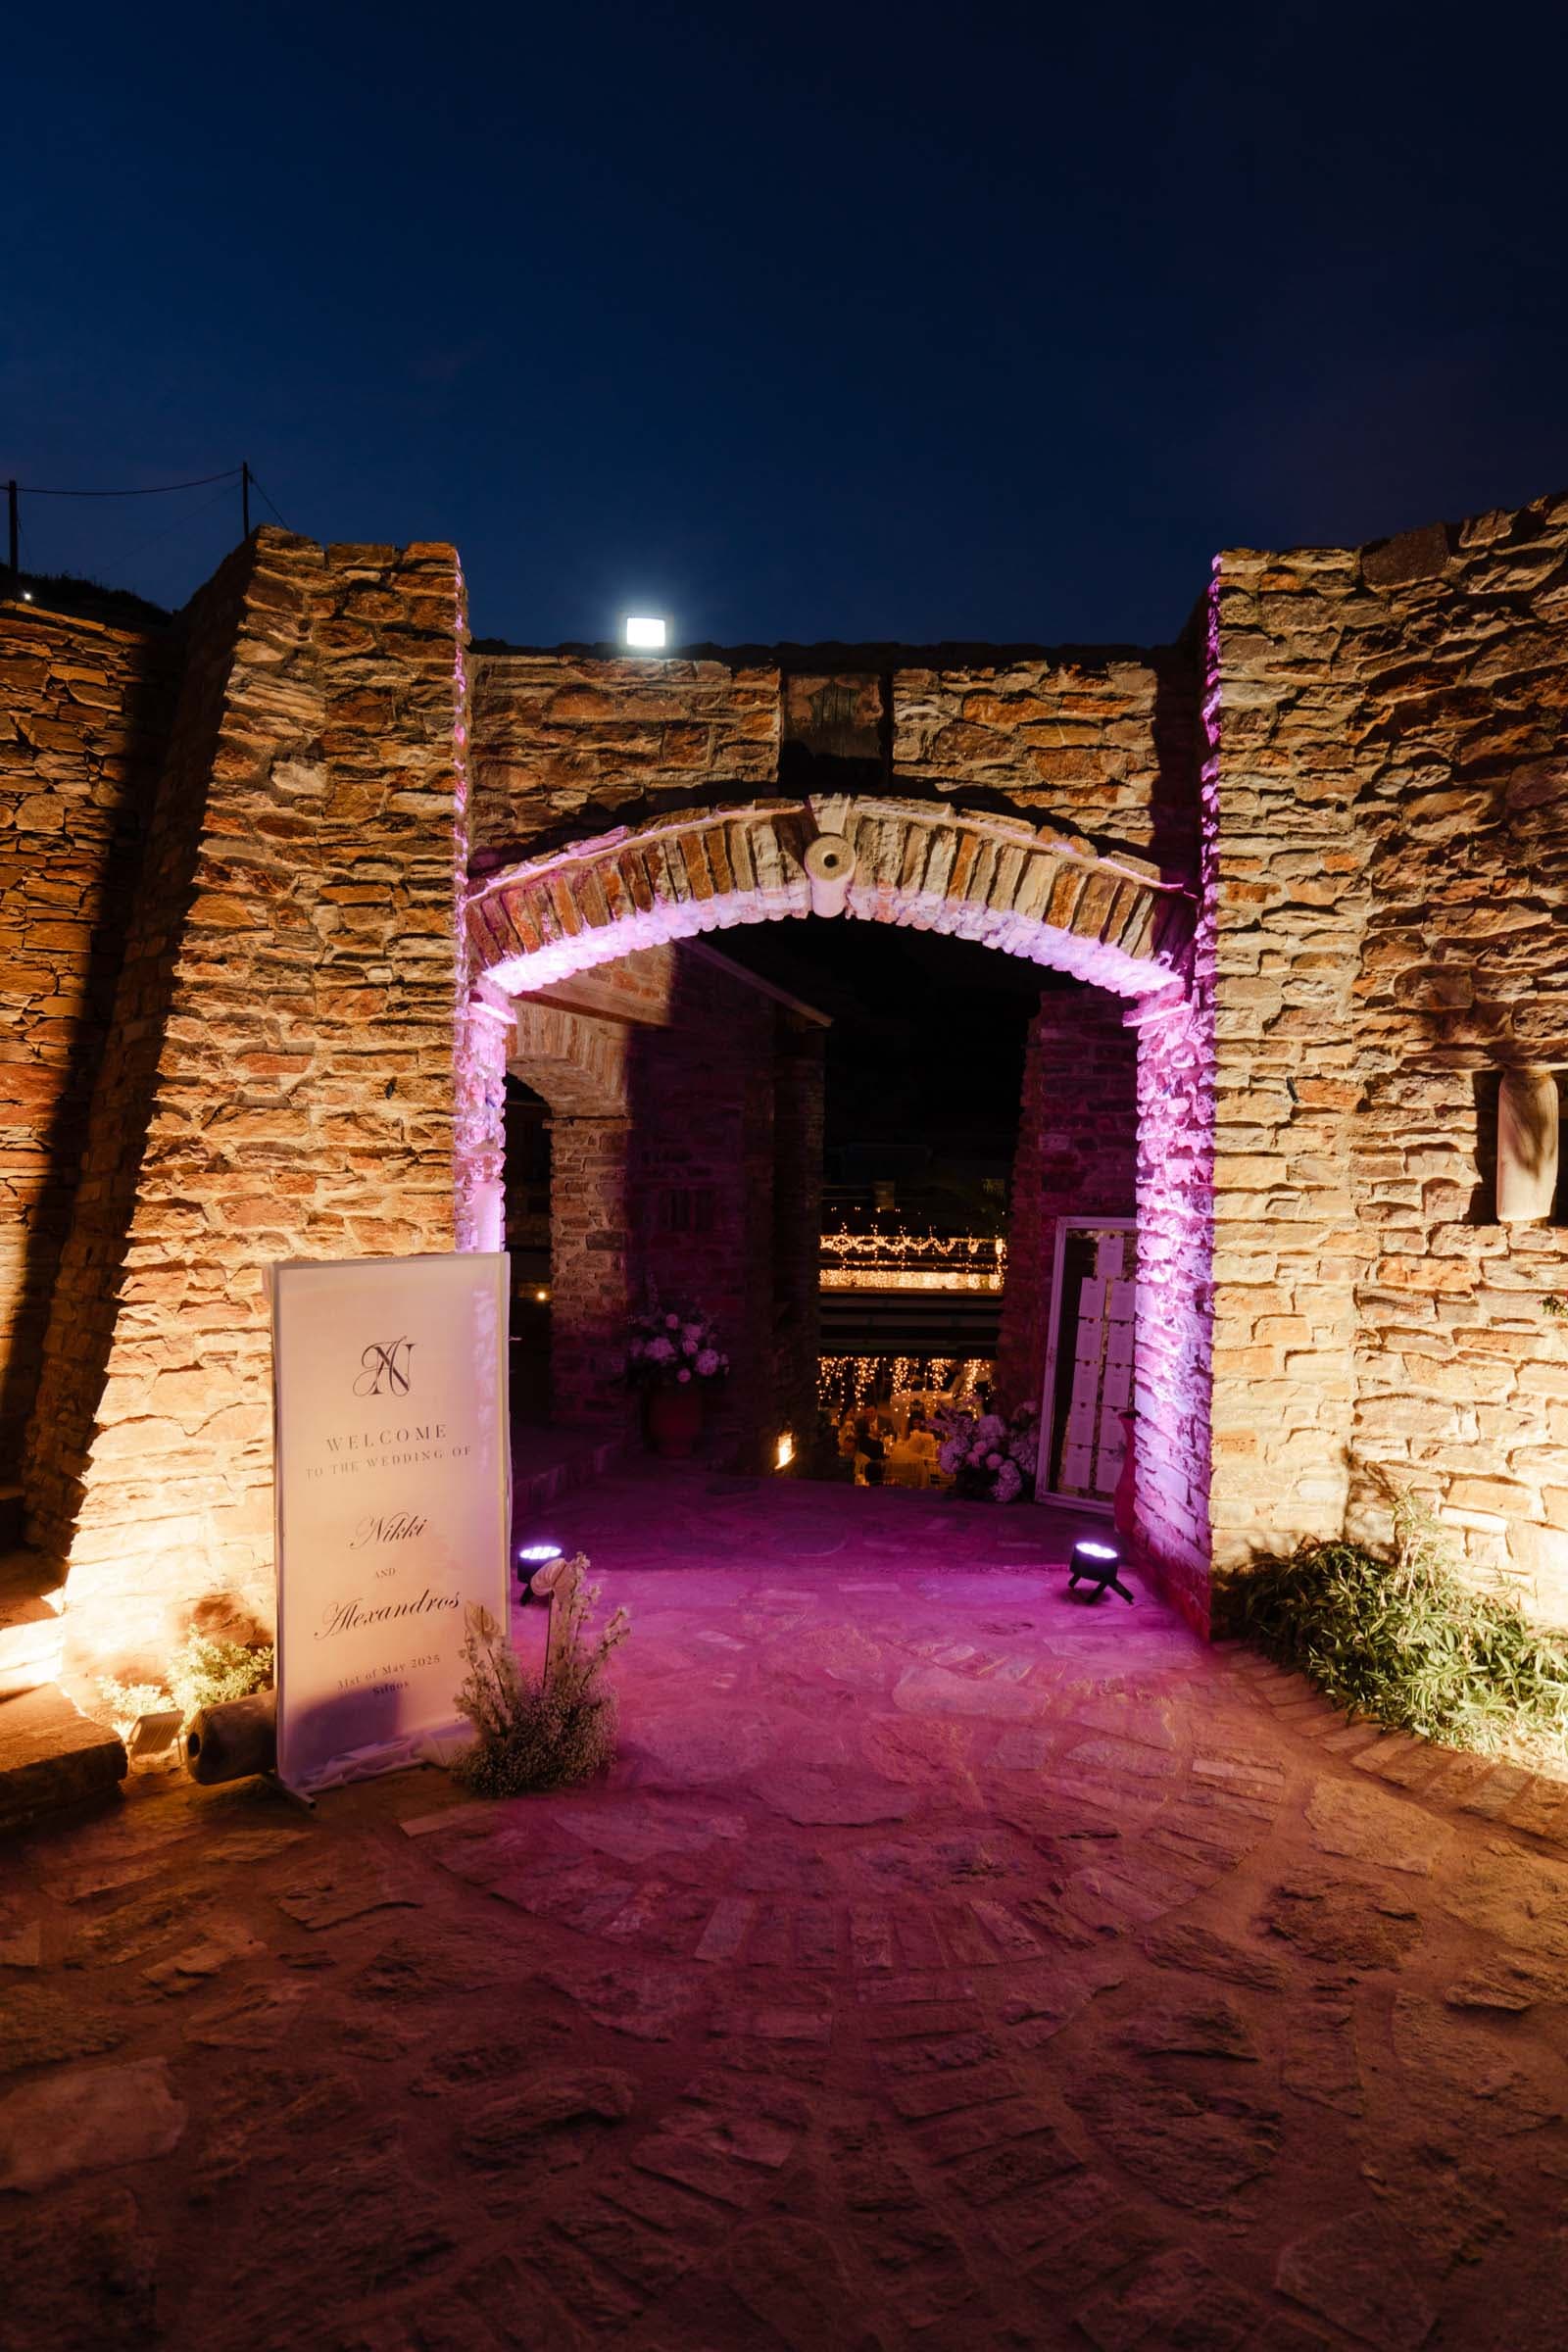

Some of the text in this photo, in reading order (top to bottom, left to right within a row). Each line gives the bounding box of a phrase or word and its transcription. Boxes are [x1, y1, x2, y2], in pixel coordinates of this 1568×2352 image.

[326, 1424, 447, 1452] WELCOME
[306, 1446, 471, 1479] TO THE WEDDING OF
[349, 1511, 427, 1550] Nikki
[375, 1568, 396, 1579] AND
[314, 1589, 461, 1641] Alexandros
[337, 1654, 440, 1689] 31st of May 2025
